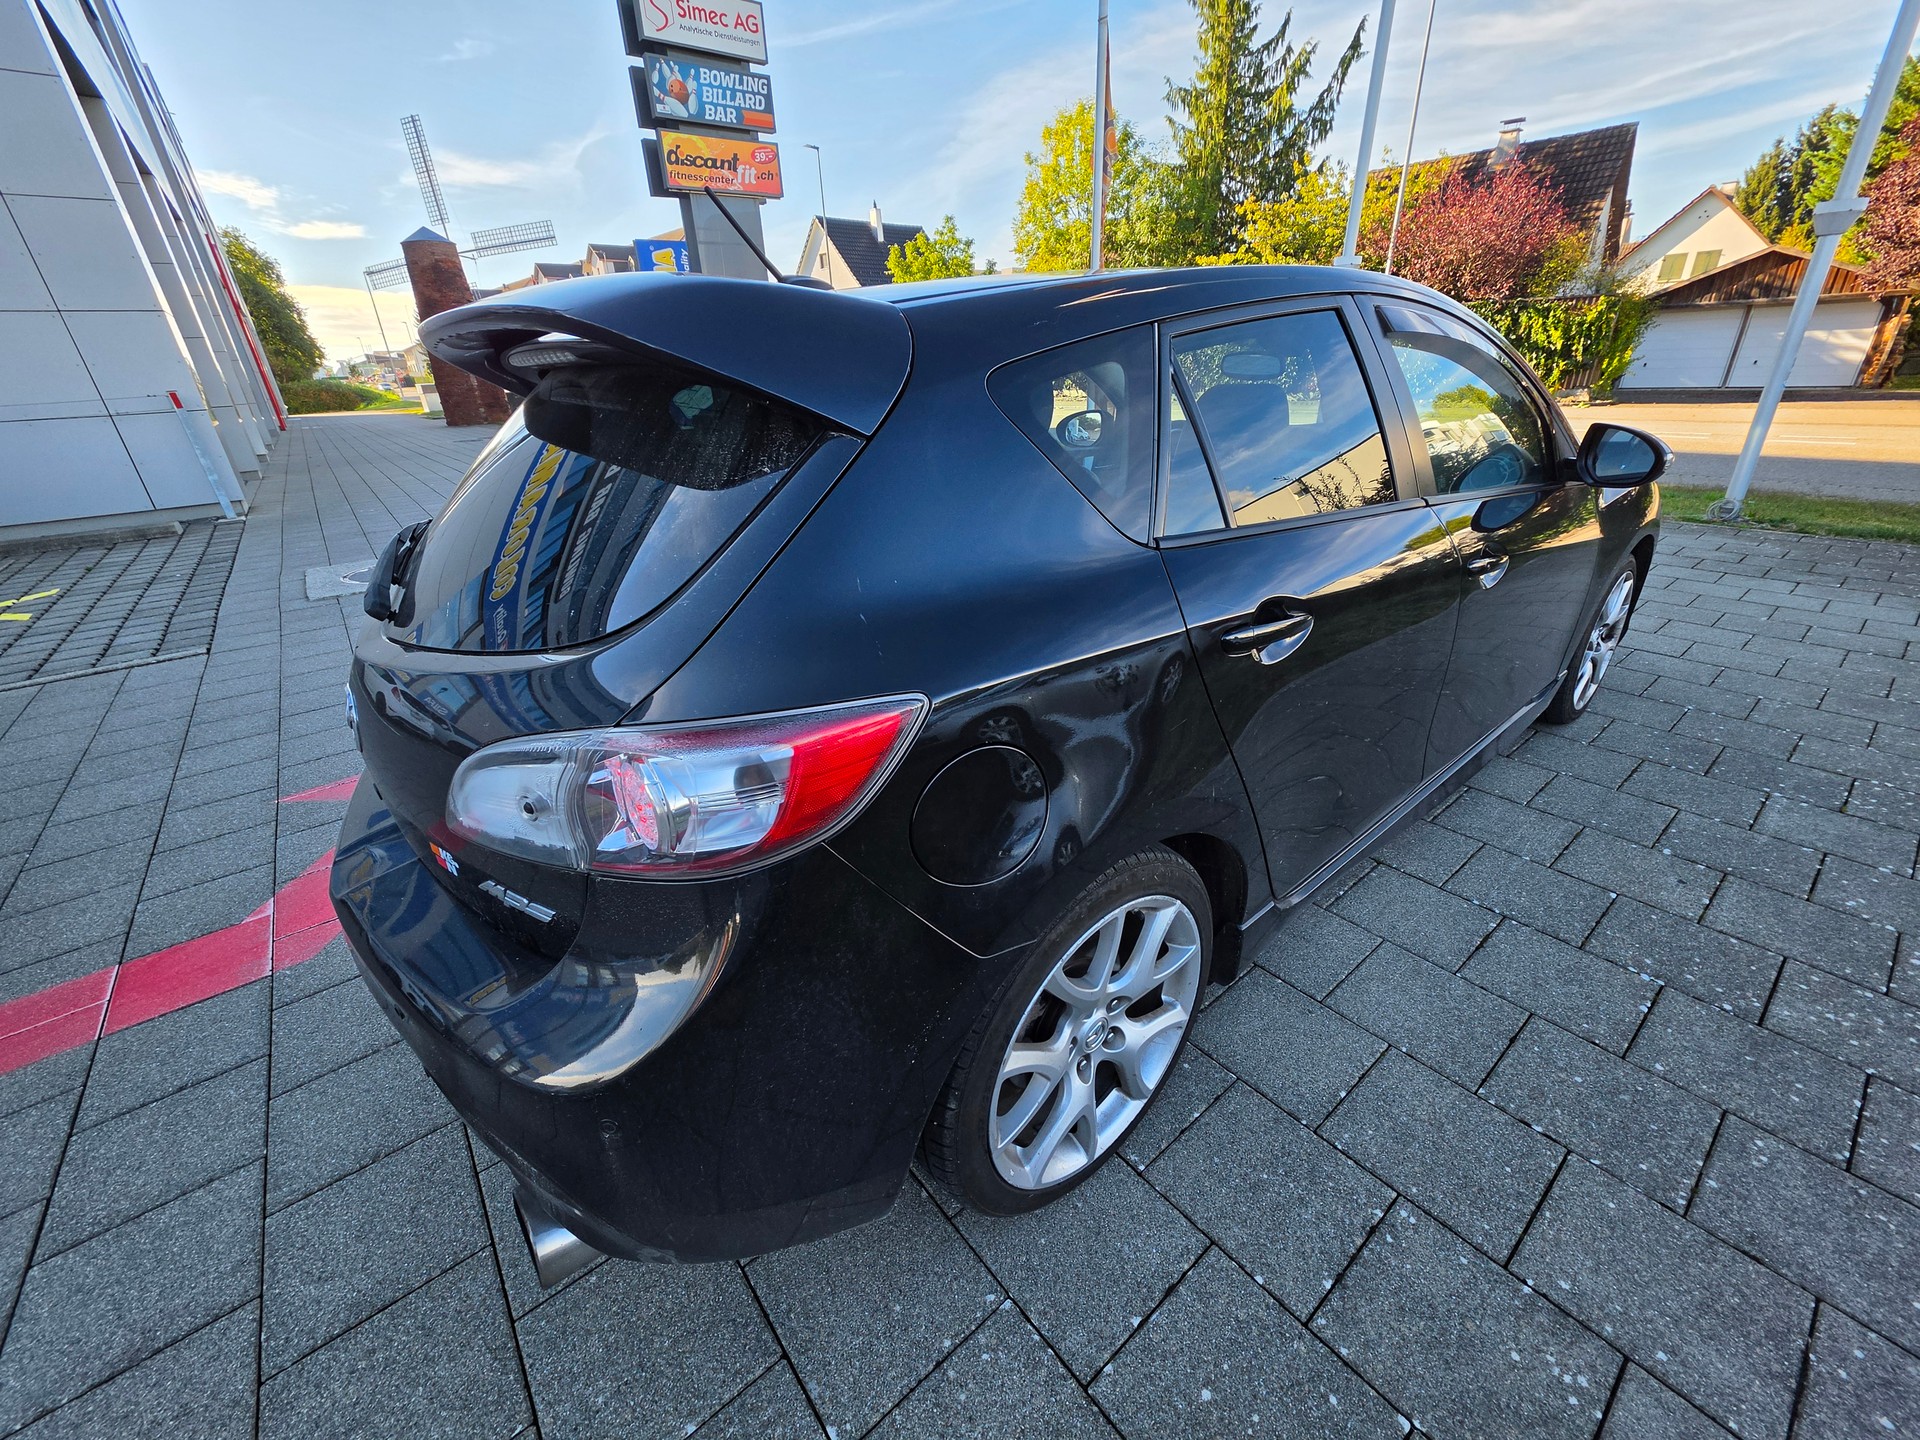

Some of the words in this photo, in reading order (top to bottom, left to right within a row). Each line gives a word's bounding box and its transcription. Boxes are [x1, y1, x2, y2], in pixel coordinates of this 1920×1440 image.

[676, 0, 729, 28] Simec
[734, 11, 760, 34] AG
[679, 23, 713, 37] Analytische
[714, 30, 761, 46] Dienstleistungen
[699, 67, 768, 94] BOWLING
[702, 86, 766, 111] BILLARD
[704, 104, 737, 123] BAR
[669, 169, 736, 185] fitnesscenter
[478, 880, 557, 923] MPS
